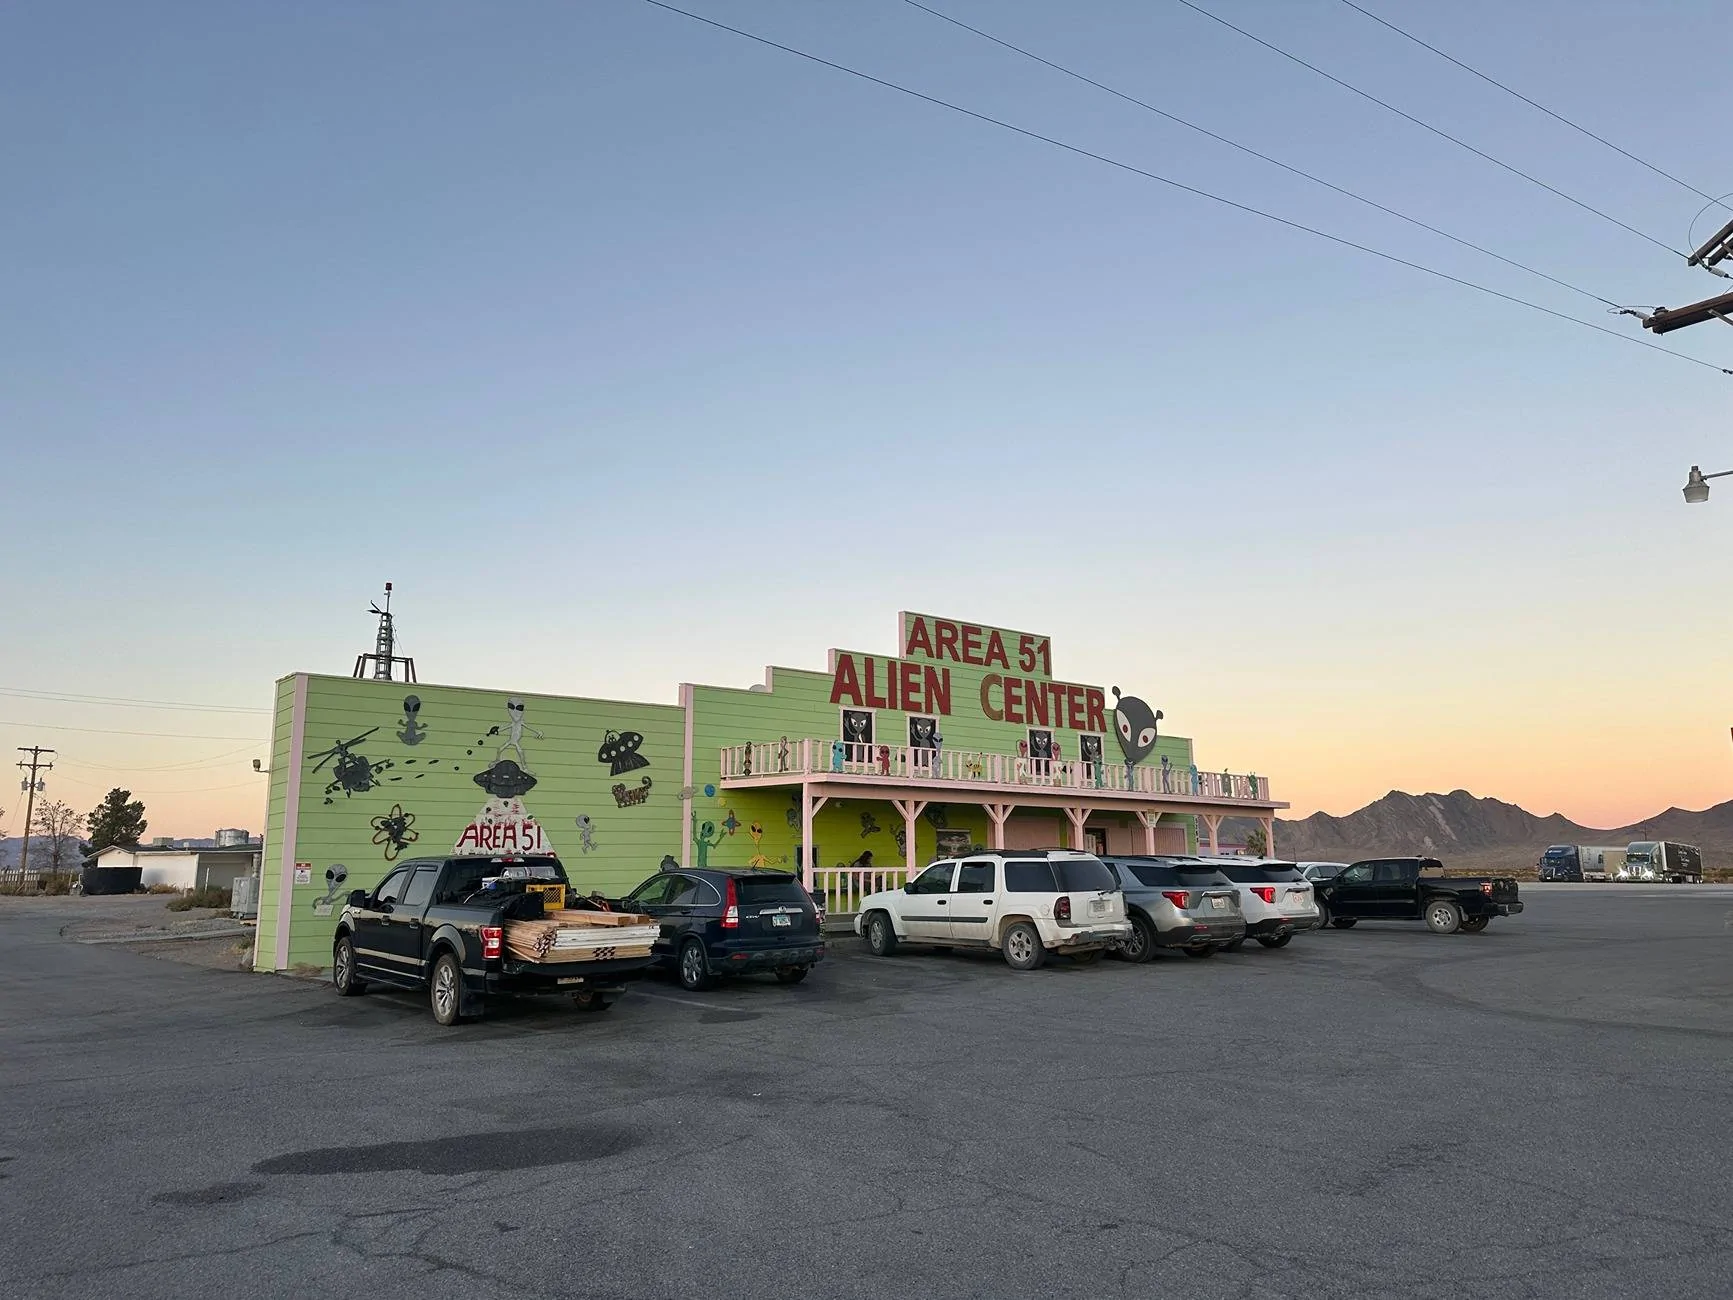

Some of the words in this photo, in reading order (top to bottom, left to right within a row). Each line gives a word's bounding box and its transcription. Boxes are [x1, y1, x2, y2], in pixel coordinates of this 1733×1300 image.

[906, 617, 1009, 669] AREA
[1018, 635, 1051, 675] 51
[830, 654, 951, 716] ALIEN
[980, 673, 1107, 733] CENTER
[457, 823, 517, 850] AREA
[522, 822, 541, 851] 51
